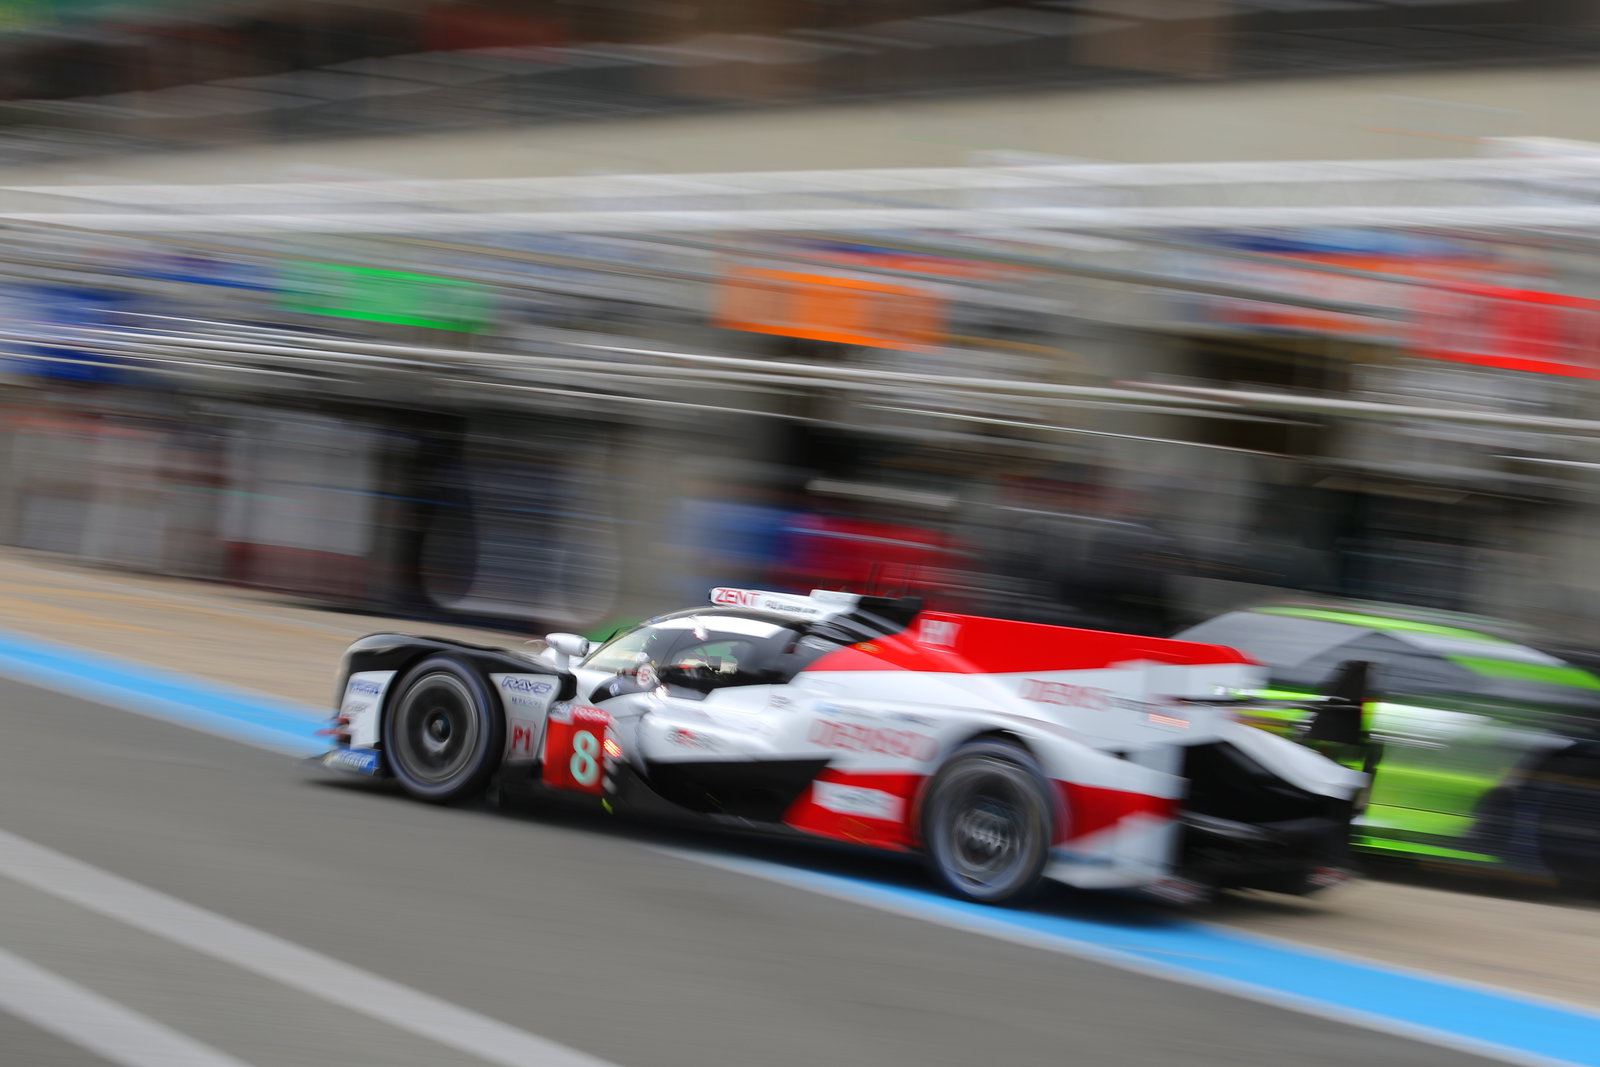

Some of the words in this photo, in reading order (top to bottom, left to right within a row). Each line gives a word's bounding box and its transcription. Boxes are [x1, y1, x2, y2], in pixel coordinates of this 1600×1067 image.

[715, 588, 760, 606] ZENT
[502, 676, 551, 694] RAYS
[512, 724, 531, 753] P1
[570, 729, 599, 787] 8
